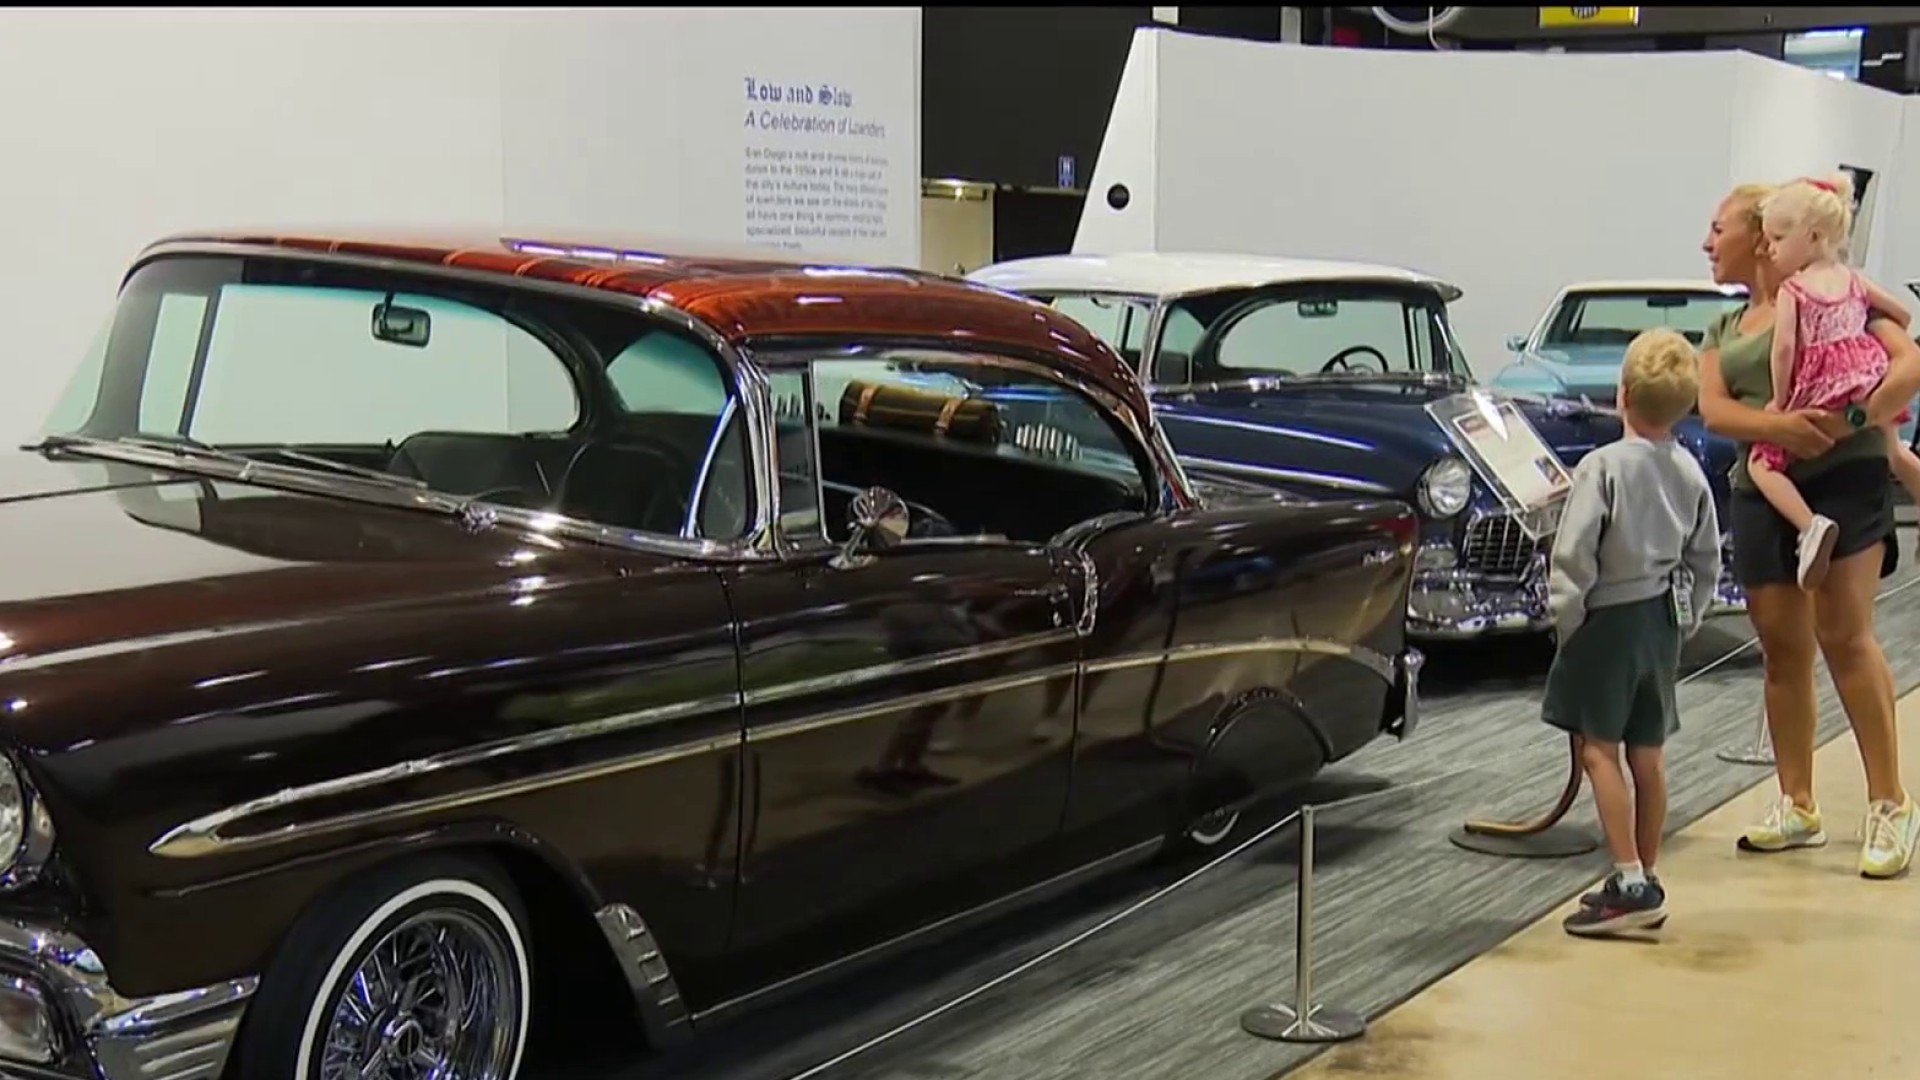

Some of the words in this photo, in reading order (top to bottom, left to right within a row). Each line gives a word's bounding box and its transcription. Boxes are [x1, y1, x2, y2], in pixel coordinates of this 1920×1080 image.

[744, 77, 782, 101] Low
[786, 85, 813, 104] and
[743, 109, 756, 128] A
[760, 110, 835, 133] Celebration
